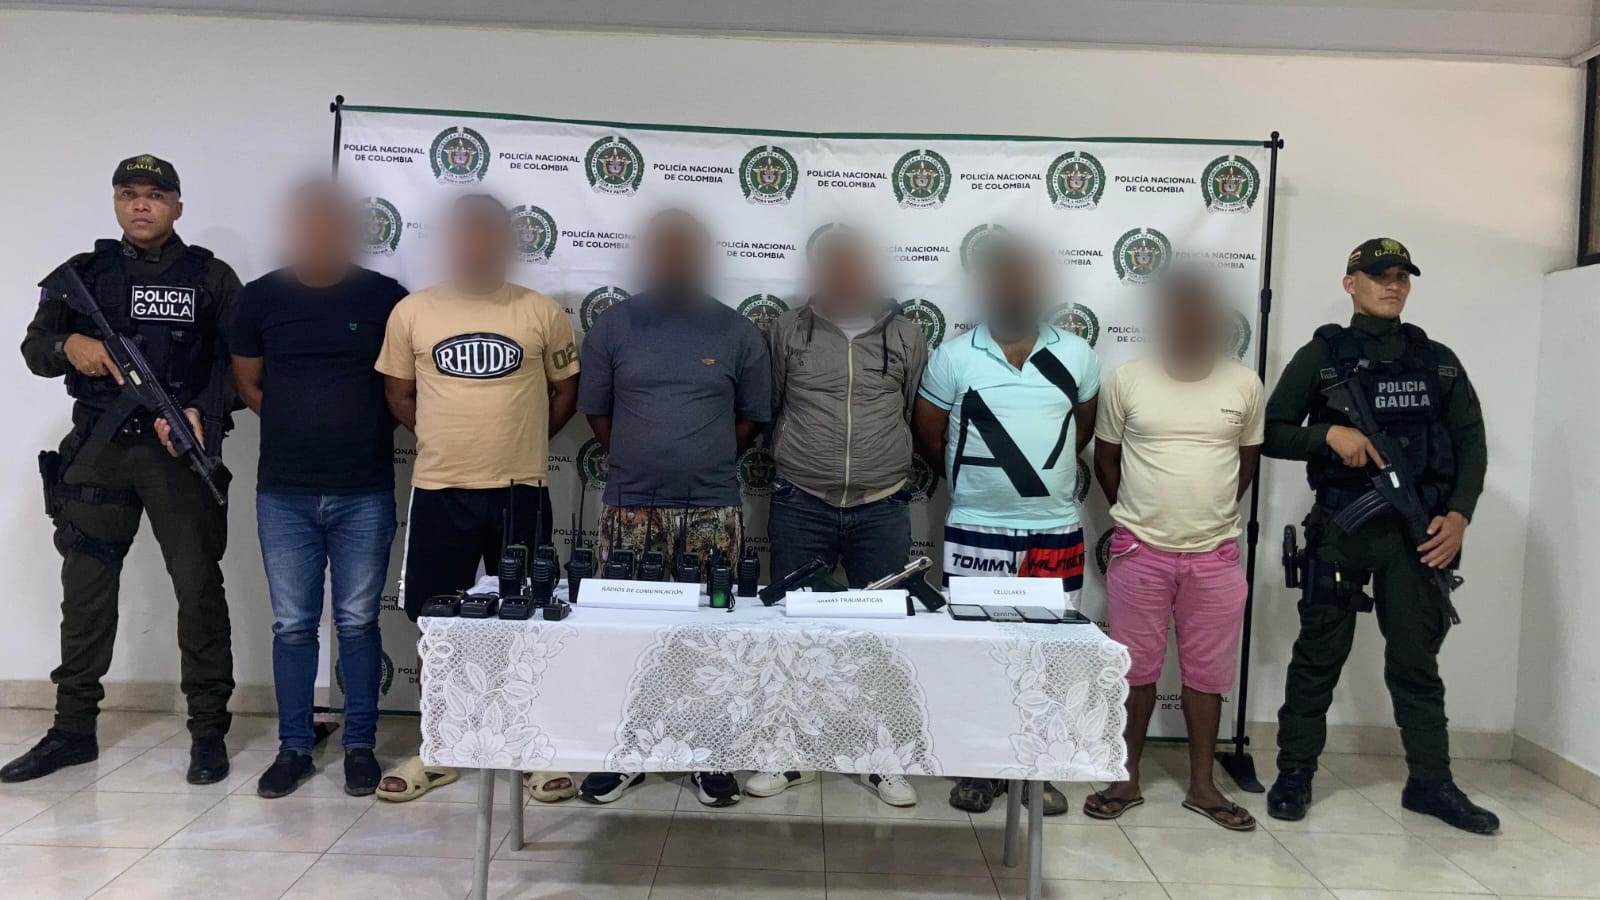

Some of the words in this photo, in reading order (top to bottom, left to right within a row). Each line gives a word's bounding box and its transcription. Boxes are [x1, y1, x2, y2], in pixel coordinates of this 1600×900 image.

[344, 144, 377, 152] POLICÍA
[380, 146, 425, 154] NACIONAL
[368, 155, 413, 163] COLOMBIA
[500, 152, 533, 160] POLICÍA
[535, 154, 580, 162] NACIONAL
[127, 163, 162, 175] GAULA
[653, 163, 687, 172] POLICÍA
[690, 166, 734, 174] NACIONAL
[678, 175, 722, 183] COLOMBIA
[961, 172, 994, 180] POLICÍA
[562, 230, 595, 238] POLICÍA
[752, 242, 796, 250] NACIONAL
[740, 251, 785, 259] COLOMBIA
[1375, 250, 1408, 258] GAULA
[135, 290, 192, 304] POLICIA
[134, 303, 192, 317] GAULA
[440, 342, 516, 373] RHUDE
[1378, 381, 1426, 393] POLICIA
[1375, 394, 1430, 408] GAULA
[952, 553, 1017, 574] TOMMY
